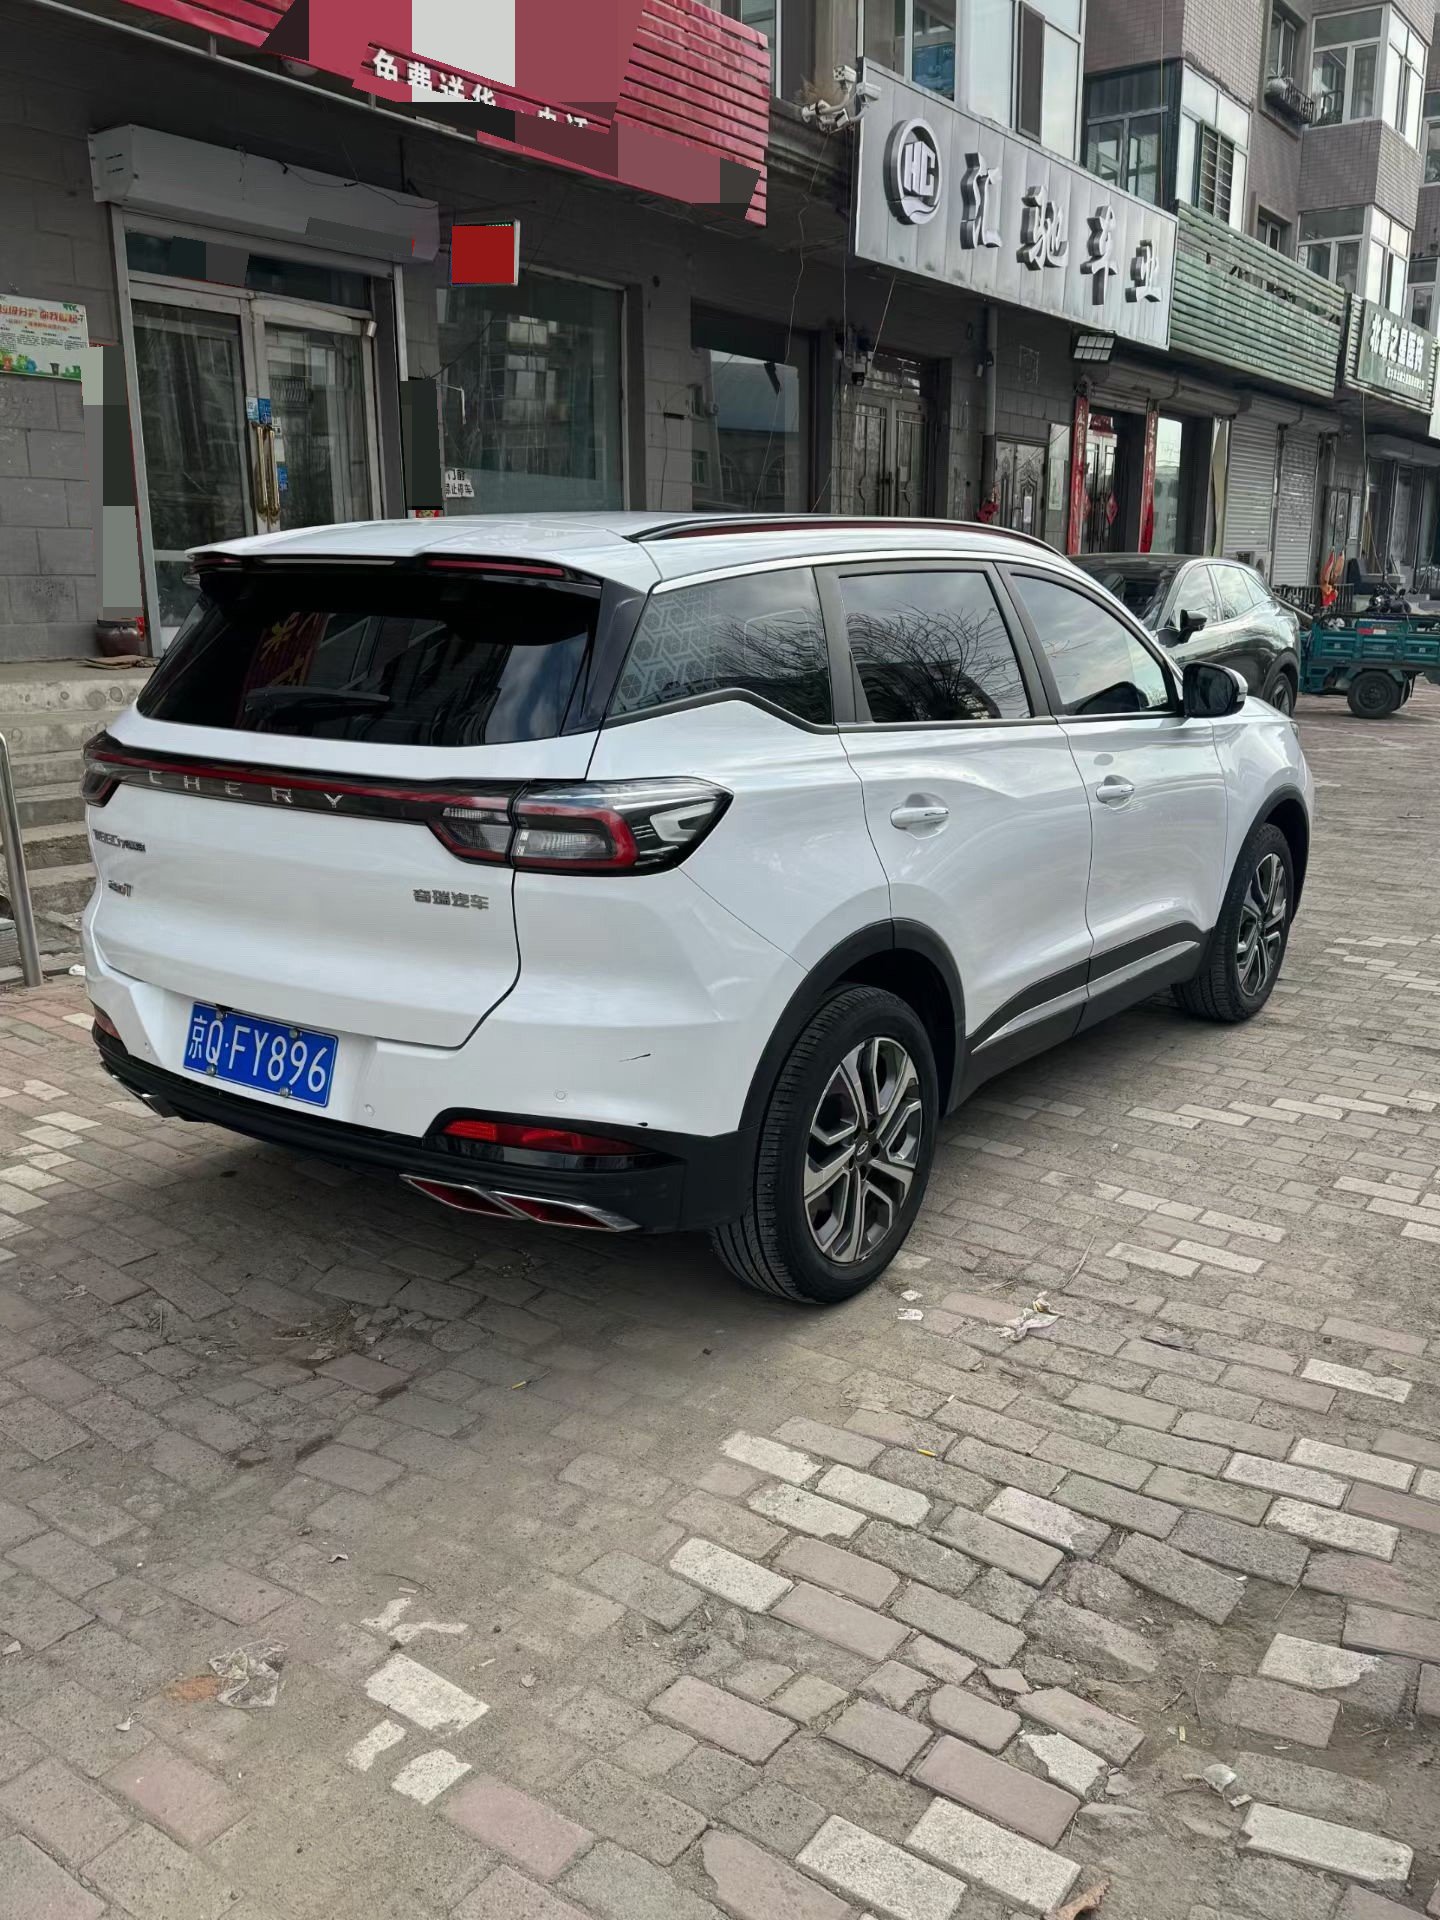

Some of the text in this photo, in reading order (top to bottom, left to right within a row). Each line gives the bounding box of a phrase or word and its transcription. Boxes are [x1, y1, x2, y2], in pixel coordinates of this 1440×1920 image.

[960, 152, 1163, 306] 汇驰车业
[149, 770, 344, 809] CHERY
[413, 888, 489, 910] 奇瑞汽车
